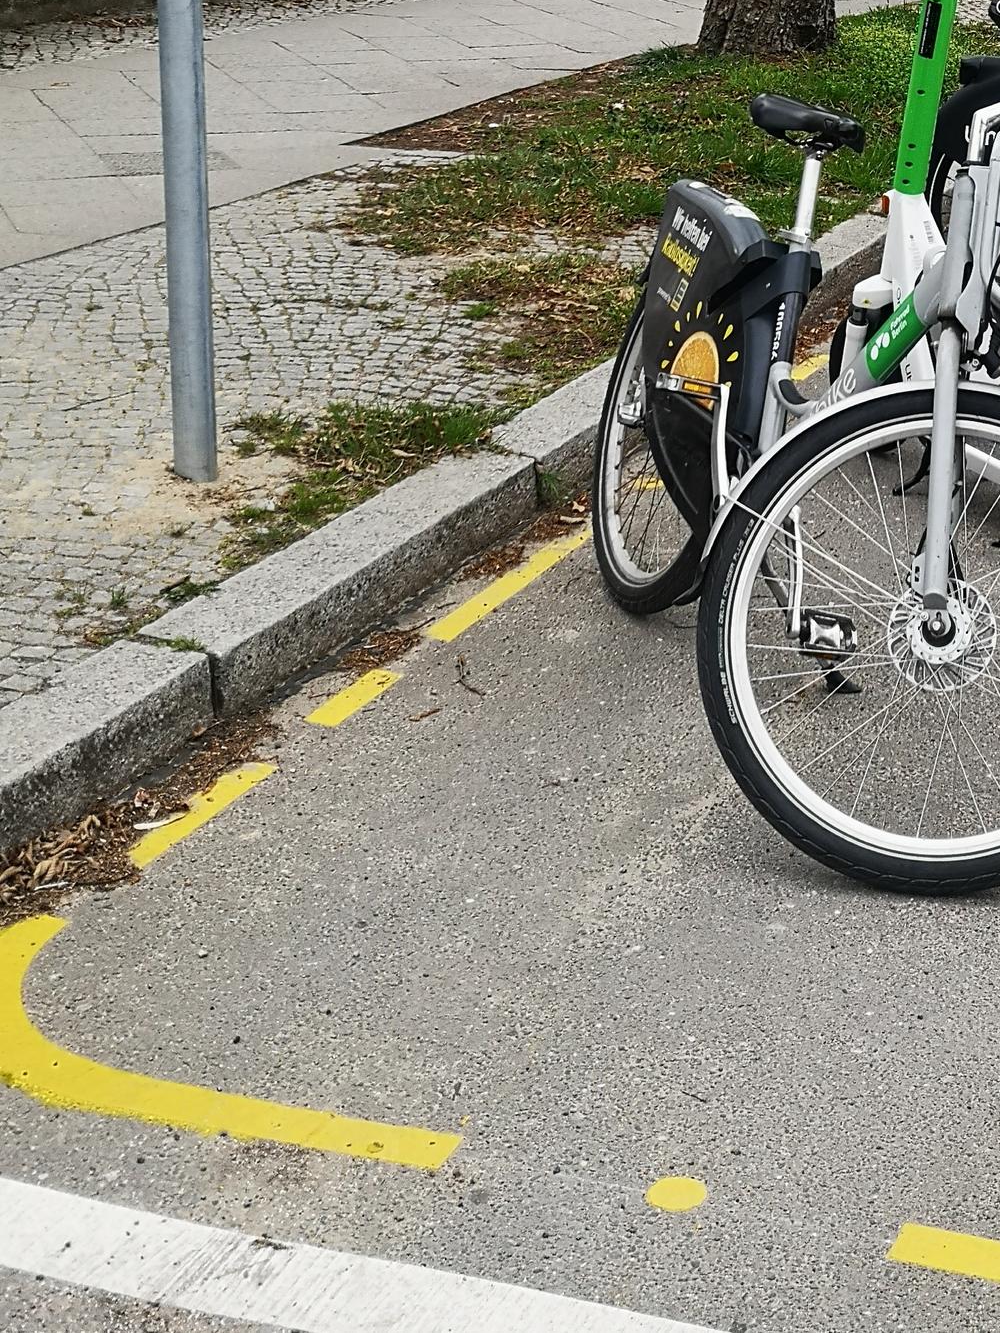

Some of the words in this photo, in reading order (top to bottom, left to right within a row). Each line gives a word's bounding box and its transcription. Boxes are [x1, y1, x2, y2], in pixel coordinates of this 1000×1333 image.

[672, 206, 685, 232] Wir
[890, 304, 910, 330] Fahrrad
[892, 321, 907, 339] Berlin
